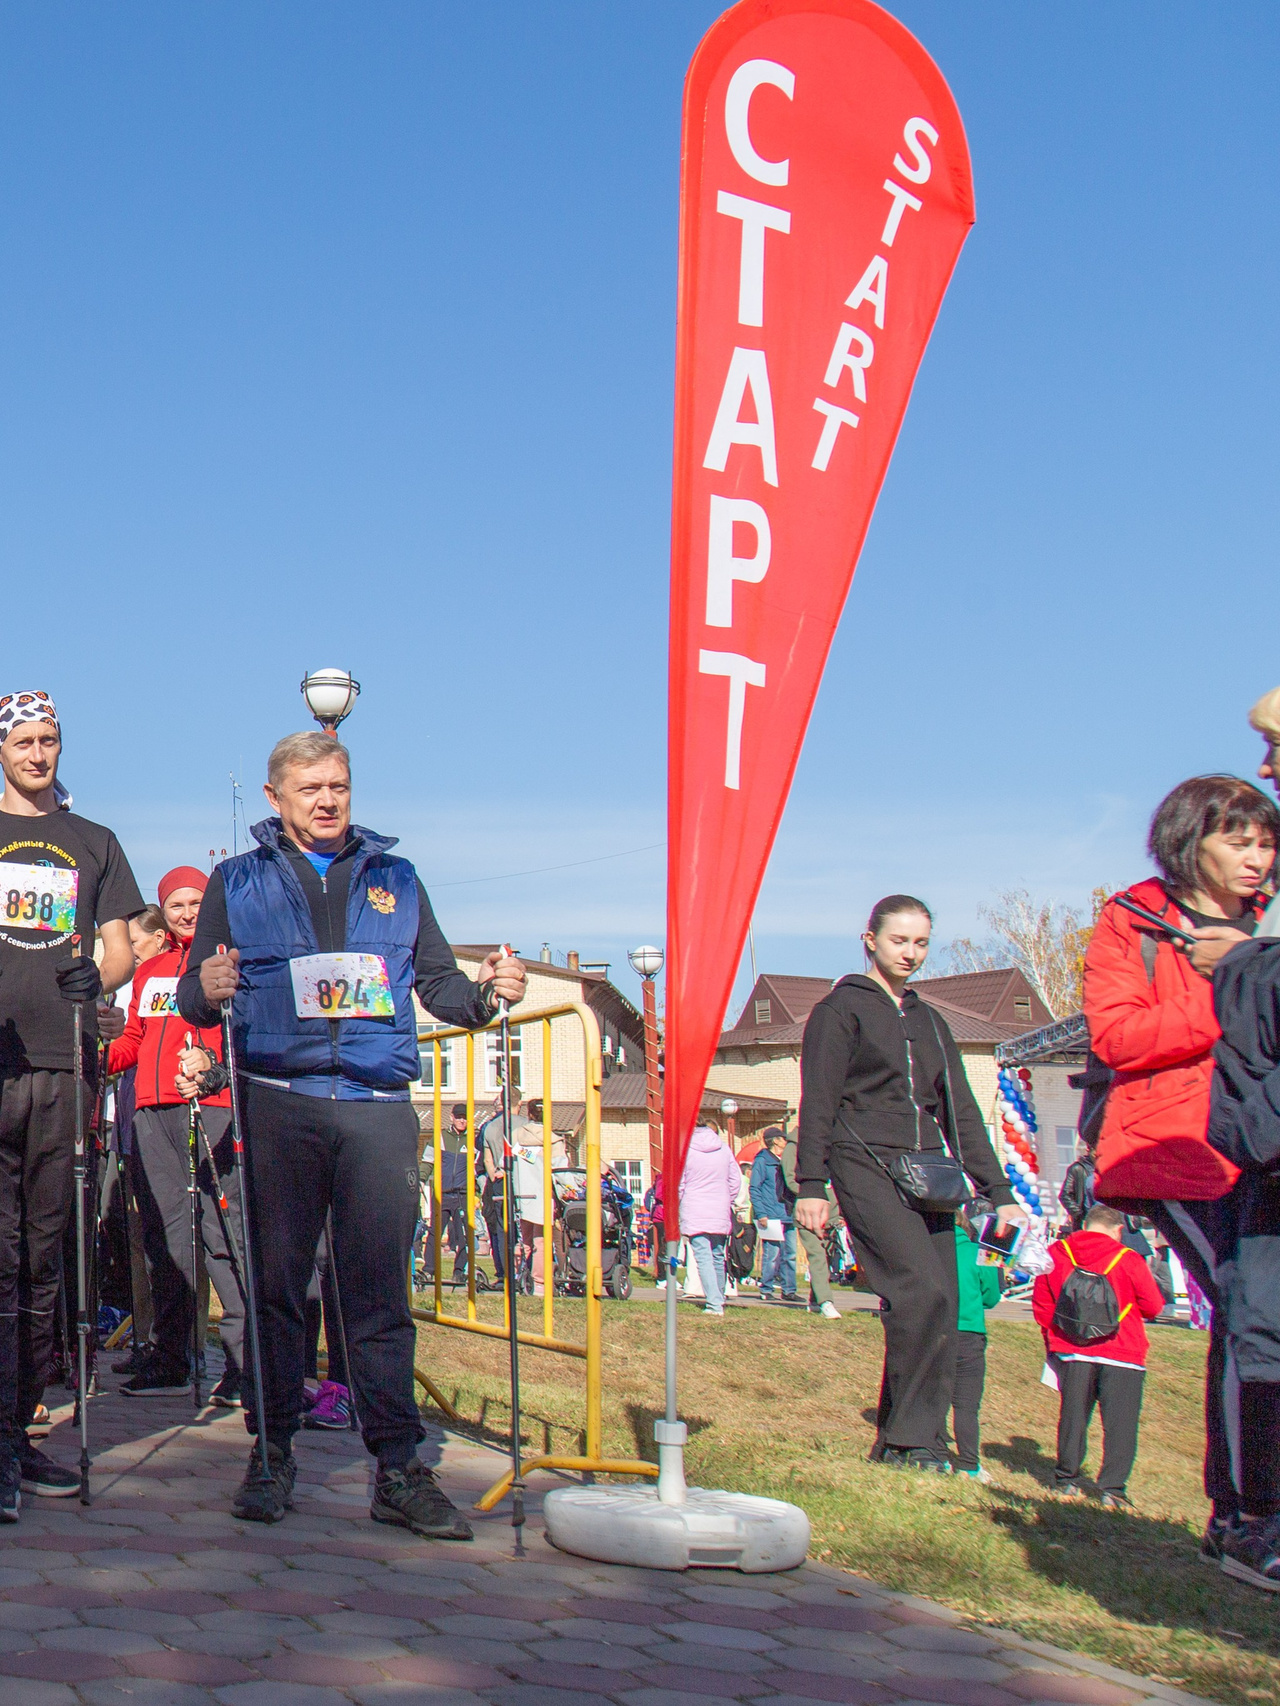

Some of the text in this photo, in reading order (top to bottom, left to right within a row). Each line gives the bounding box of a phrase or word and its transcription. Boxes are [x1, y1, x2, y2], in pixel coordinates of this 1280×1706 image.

[810, 115, 940, 472] START
[697, 58, 796, 790] СТАРТ
[46, 842, 77, 867] ходить
[6, 889, 54, 922] 838
[7, 936, 47, 951] северной
[317, 978, 370, 1010] 824
